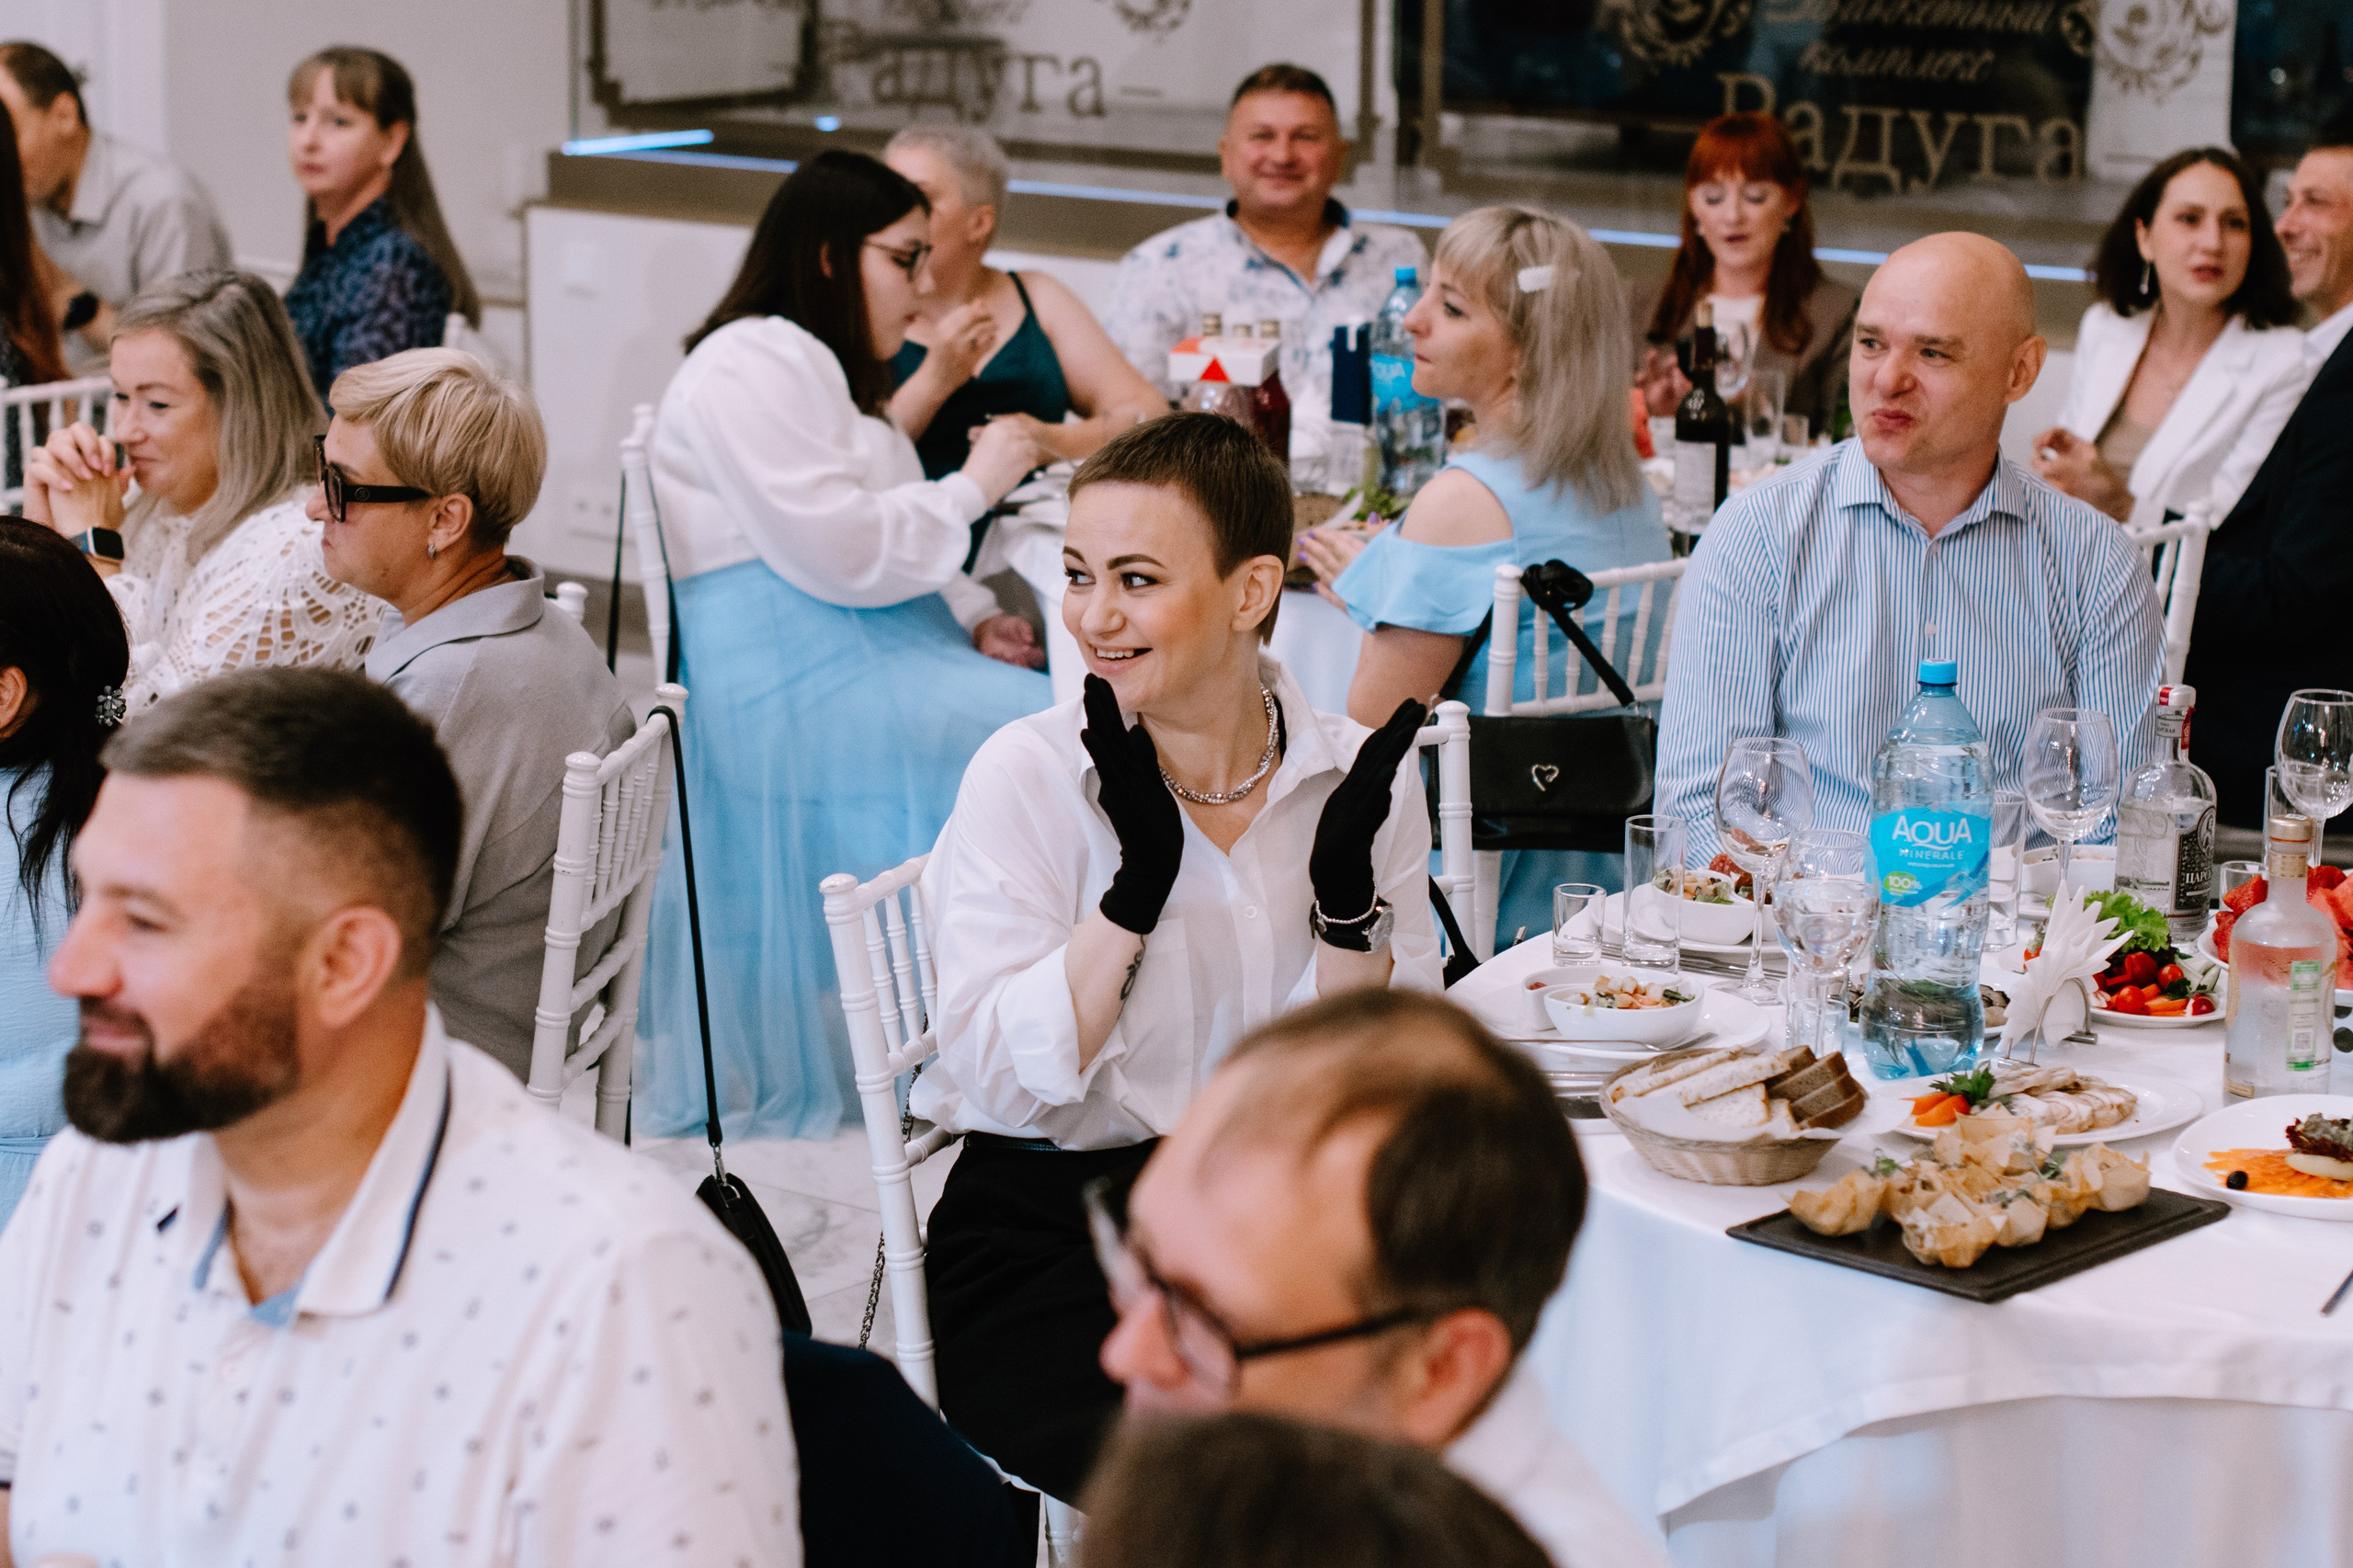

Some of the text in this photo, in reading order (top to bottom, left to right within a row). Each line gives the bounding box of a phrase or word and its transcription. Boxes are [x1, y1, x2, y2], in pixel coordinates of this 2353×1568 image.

[1892, 814, 1972, 847] AQUA
[1898, 847, 1966, 861] MINERALE
[1888, 875, 1923, 891] 100%
